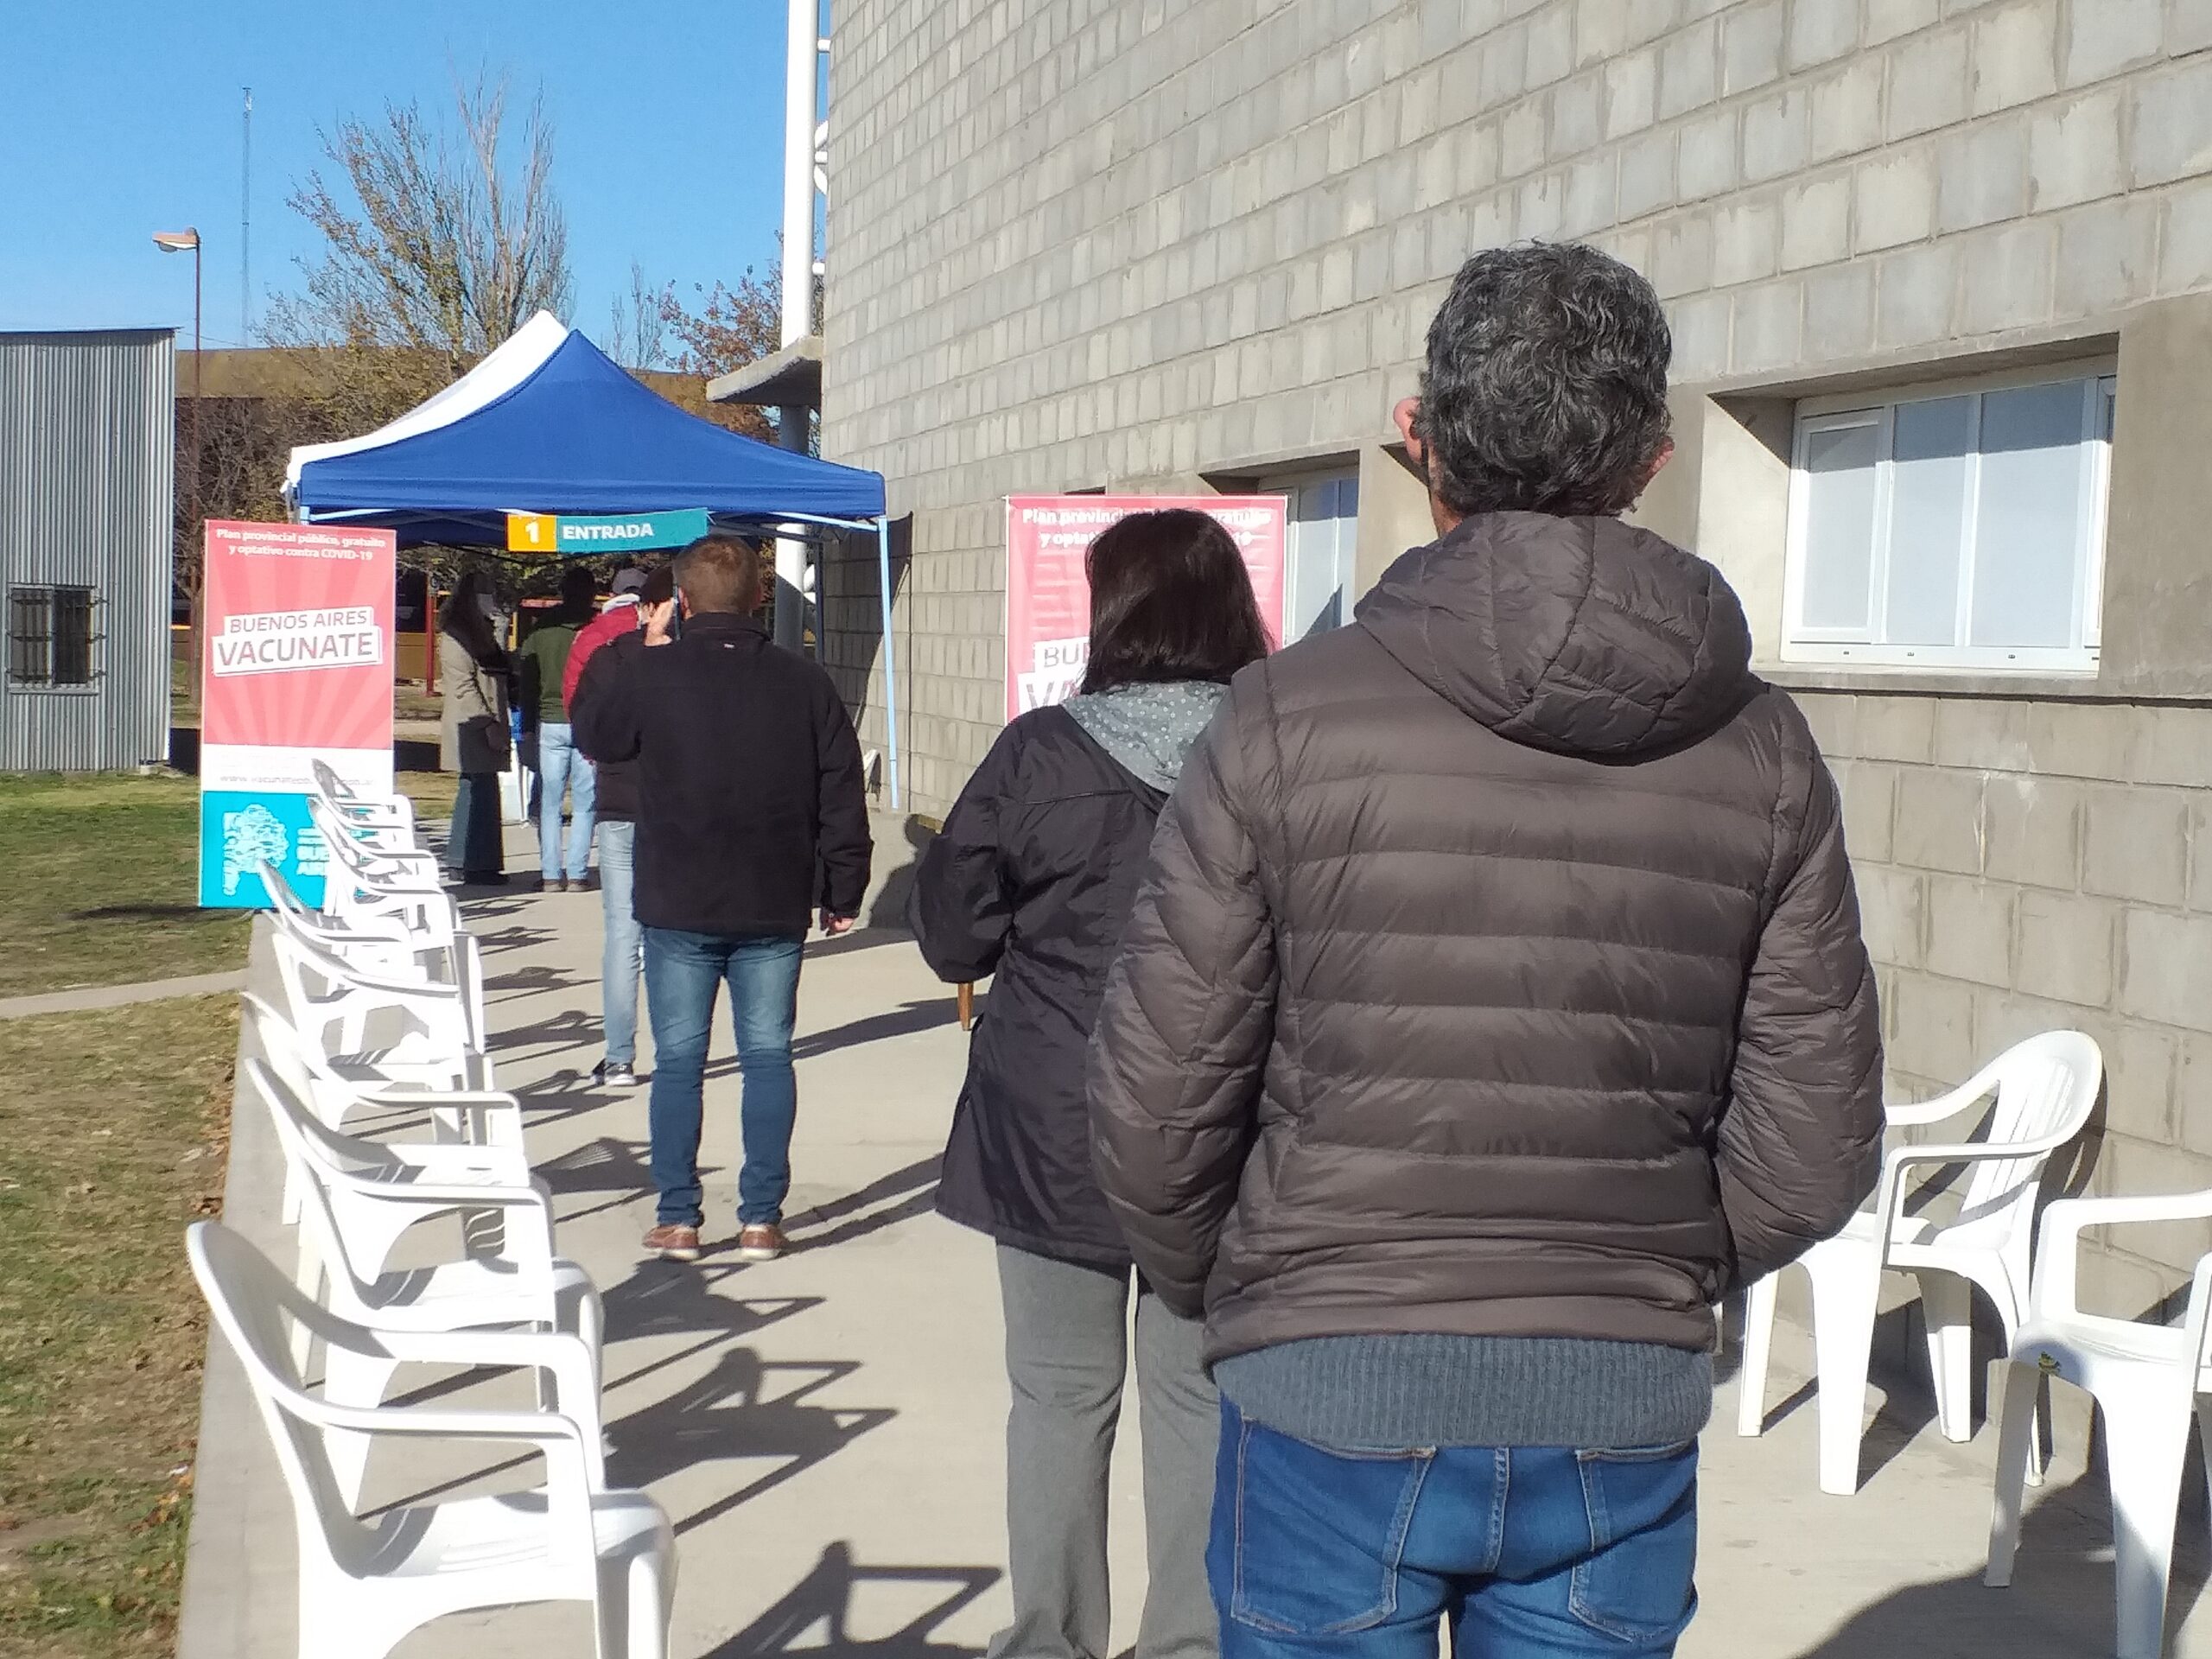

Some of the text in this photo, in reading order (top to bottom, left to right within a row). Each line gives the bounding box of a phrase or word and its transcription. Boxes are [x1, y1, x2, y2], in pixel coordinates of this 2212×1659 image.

[1022, 508, 1057, 524] Plan
[1059, 506, 1124, 526] provinci
[216, 528, 241, 539] Plan
[242, 531, 296, 543] provincial
[341, 537, 386, 548] gratuito
[524, 520, 654, 544] 1 ENTRADA
[1039, 532, 1051, 549] y
[228, 545, 373, 561] y optativo contra COVID-19
[230, 610, 367, 633] BUENOS AIRES
[218, 632, 373, 666] VACUNATE
